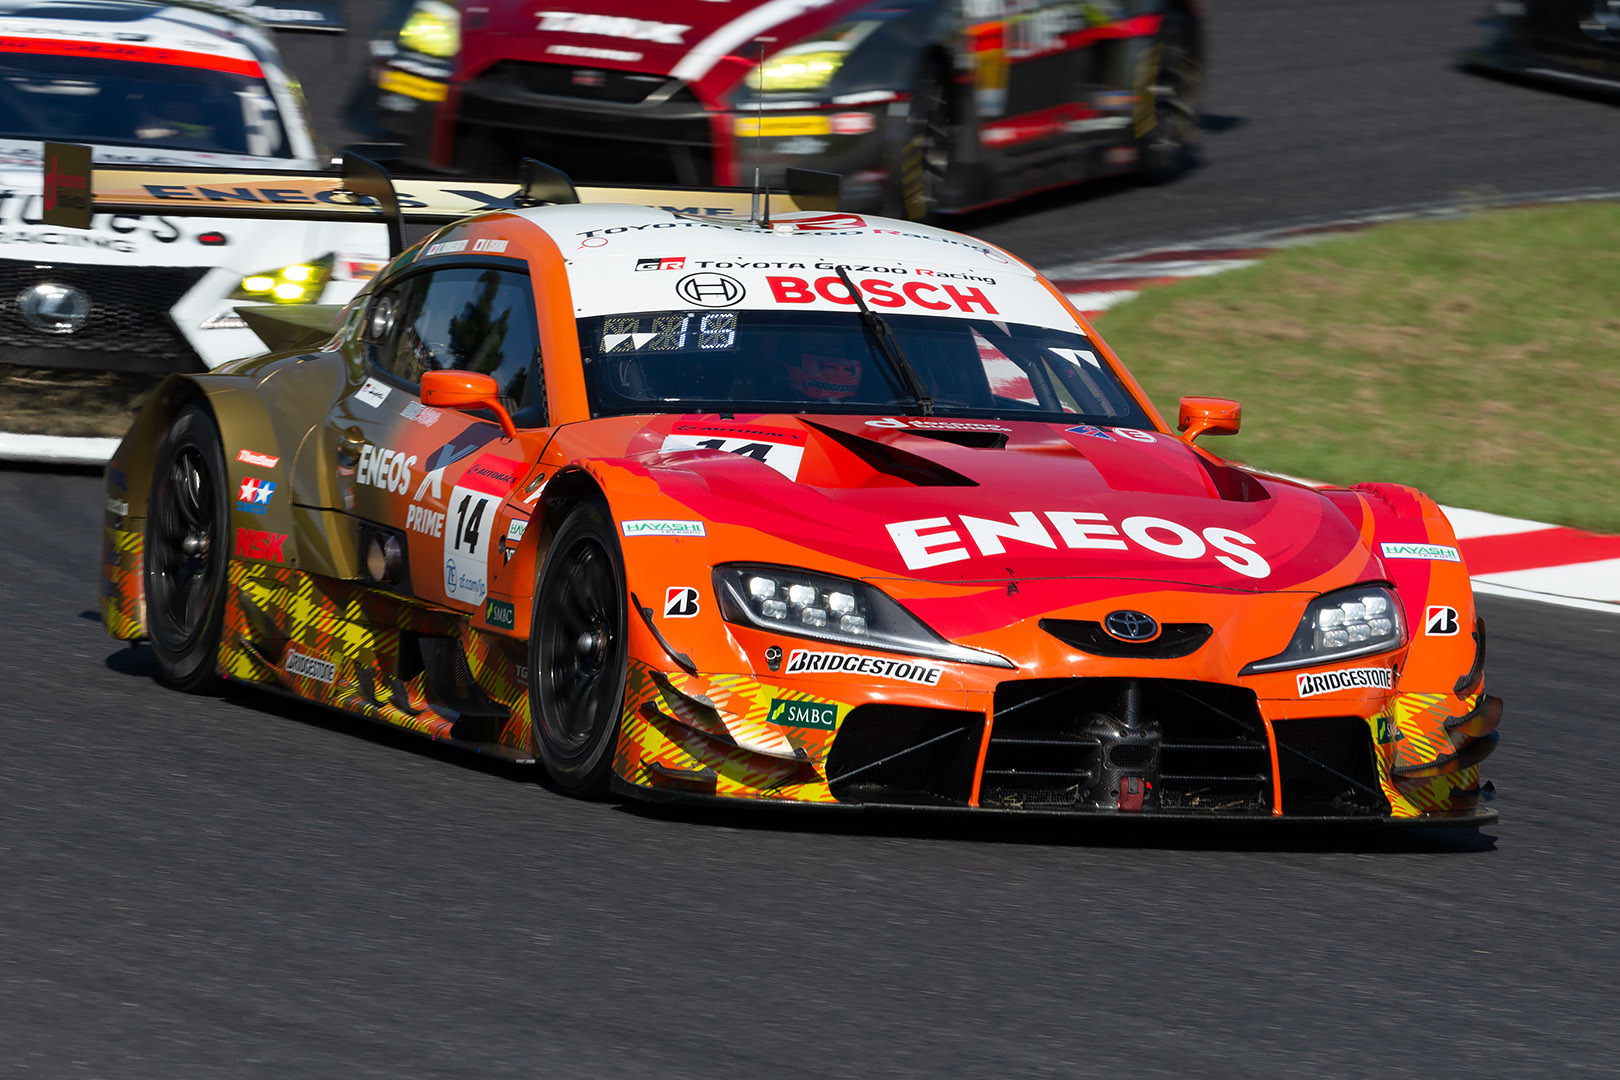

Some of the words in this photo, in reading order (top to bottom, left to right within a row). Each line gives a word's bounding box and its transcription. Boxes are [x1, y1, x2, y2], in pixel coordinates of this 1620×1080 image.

[873, 228, 990, 253] Racing
[695, 261, 806, 269] TOYOTA
[814, 261, 908, 275] GAZOO
[915, 268, 997, 285] Racing
[766, 275, 1000, 315] BOSCH
[696, 438, 773, 463] 14
[356, 444, 417, 496] ENEOS
[476, 468, 519, 484] AUTOBACS
[405, 504, 446, 539] PRIME
[454, 494, 489, 555] 14
[627, 523, 701, 532] HAYASHI
[234, 527, 290, 563] NSK
[884, 511, 1272, 580] ENEOS
[1386, 545, 1456, 558] HAYASHI
[493, 605, 513, 625] SMBC
[788, 651, 940, 684] BRIDGESTONE
[1298, 669, 1392, 696] BRIDGESTONE
[788, 706, 833, 726] SMBC
